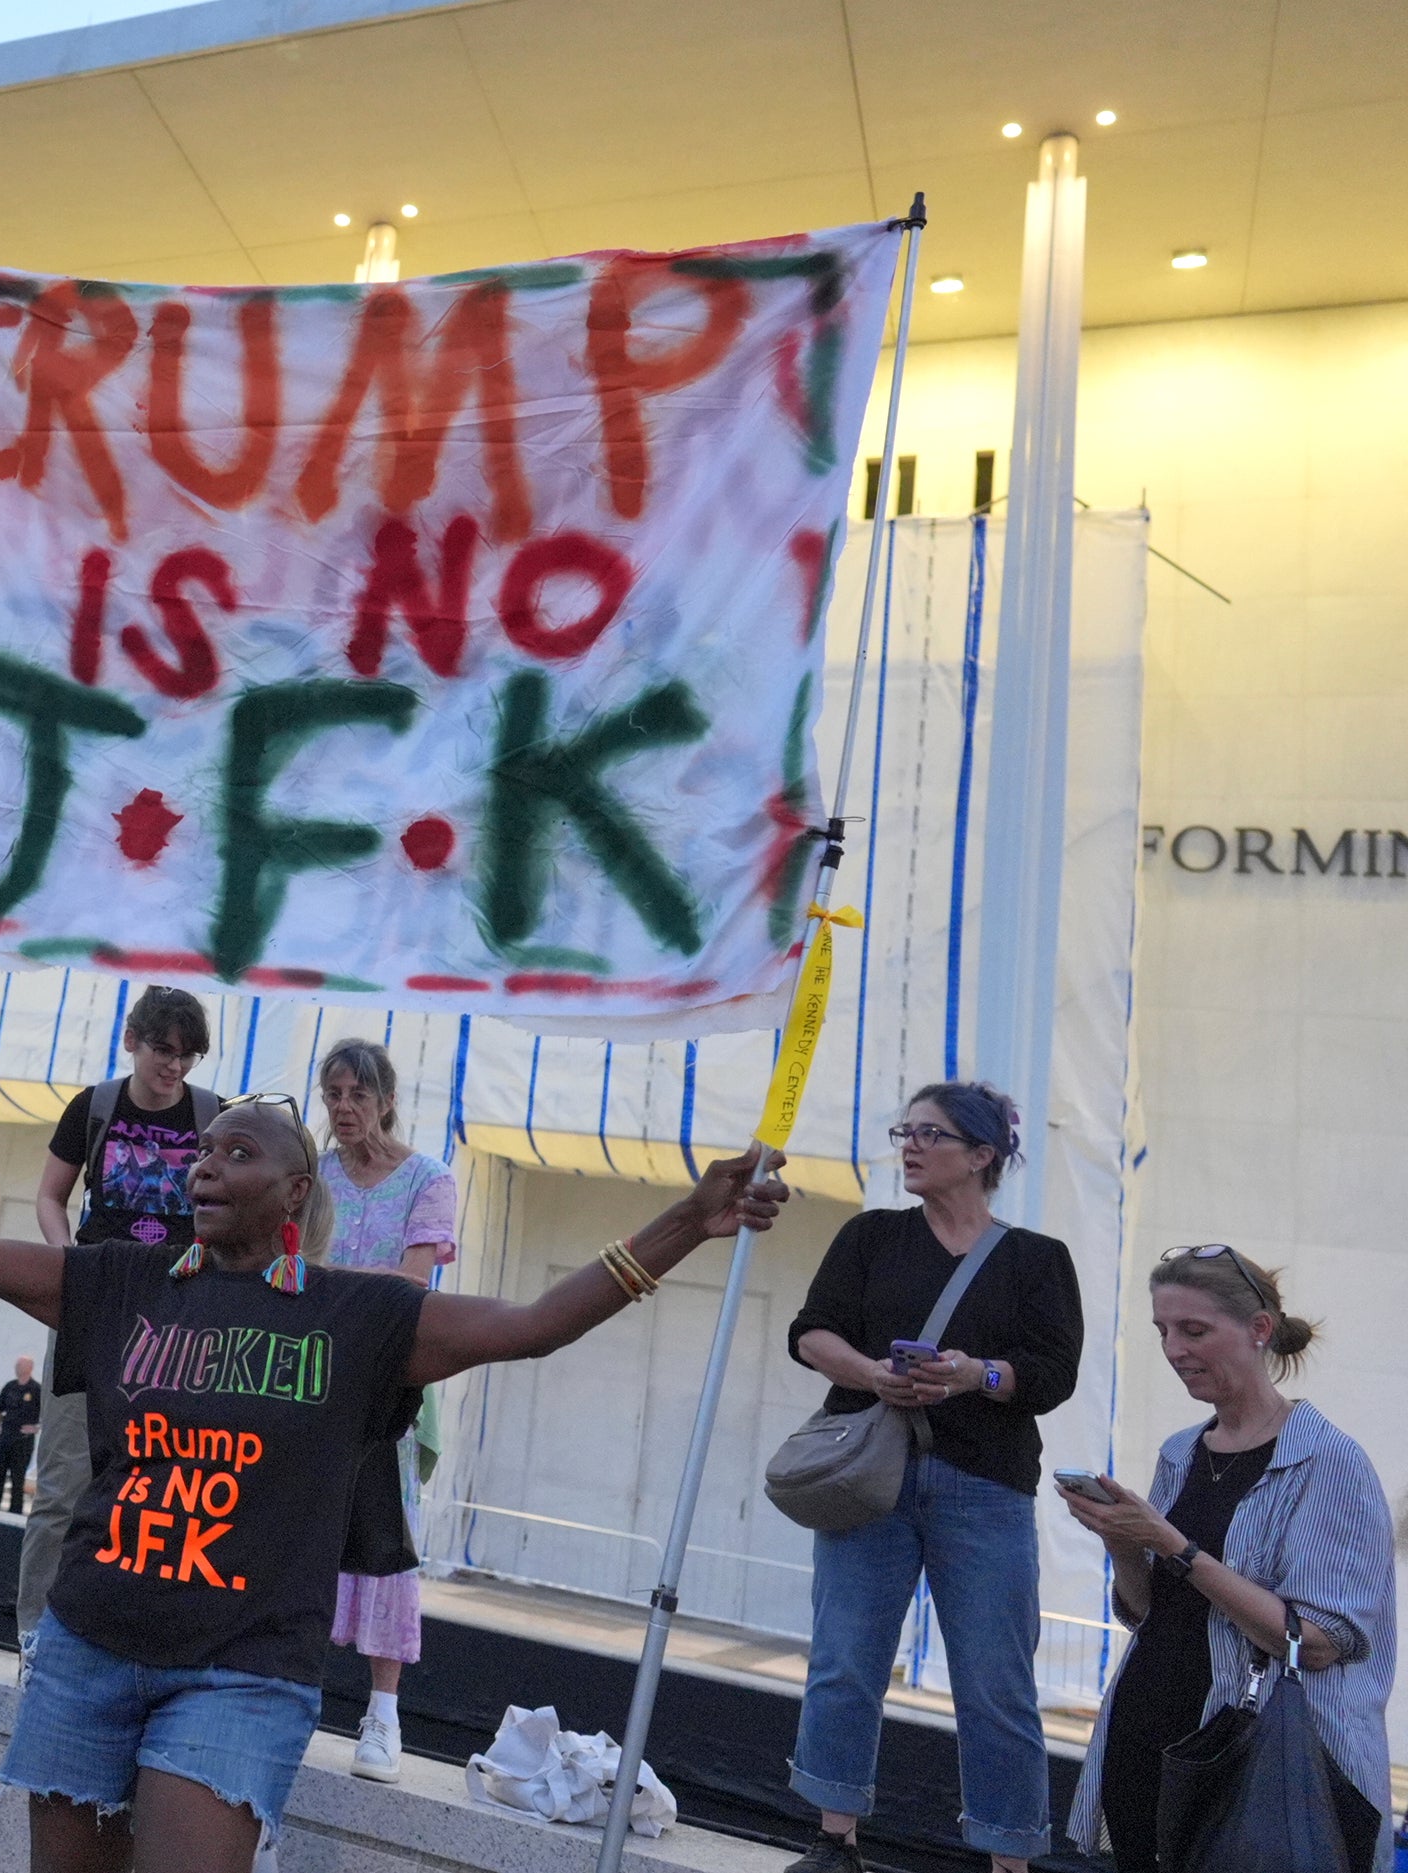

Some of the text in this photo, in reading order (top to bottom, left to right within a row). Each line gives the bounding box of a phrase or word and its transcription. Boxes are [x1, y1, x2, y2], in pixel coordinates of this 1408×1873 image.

[69, 513, 635, 700] IS NO
[814, 957, 832, 985] THE
[795, 993, 823, 1056] KENNEDY
[116, 1313, 333, 1405] WICKED
[124, 1412, 263, 1474] tRump
[117, 1465, 240, 1518] is NO
[94, 1505, 246, 1591] J.F.K.
